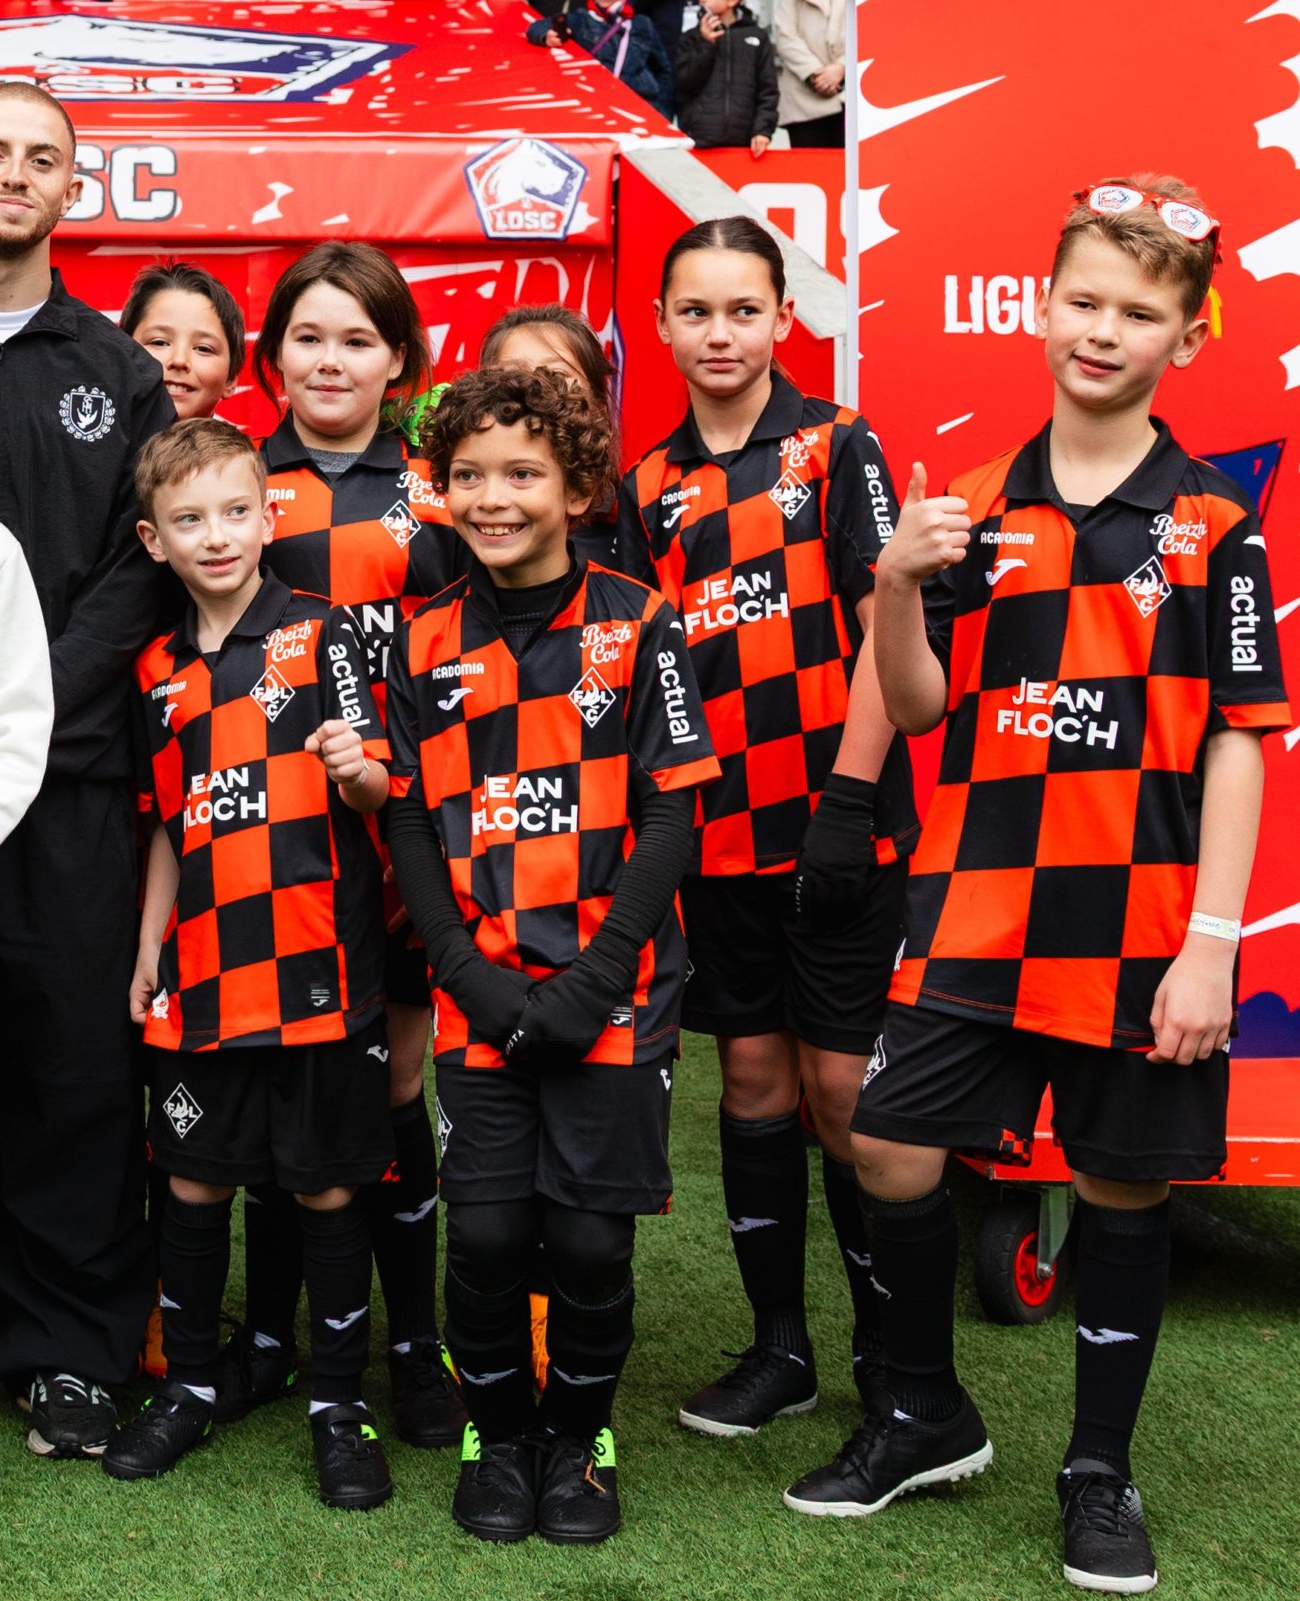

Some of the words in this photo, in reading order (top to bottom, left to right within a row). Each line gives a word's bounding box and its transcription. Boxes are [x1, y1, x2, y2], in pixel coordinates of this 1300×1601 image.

[495, 209, 557, 230] LOSC
[942, 274, 1052, 335] LIGU
[408, 488, 446, 509] Cola
[864, 463, 896, 544] actua
[1149, 513, 1208, 539] Breizh
[1157, 534, 1198, 556] Cola
[696, 570, 772, 606] JEAN
[262, 619, 313, 650] Breizh
[1230, 575, 1263, 673] actual
[271, 642, 307, 663] Cola
[328, 642, 371, 729] actual
[657, 650, 699, 745] actual
[1012, 676, 1104, 713] JEAN
[187, 766, 250, 799] EAN
[480, 774, 563, 803] JEAN
